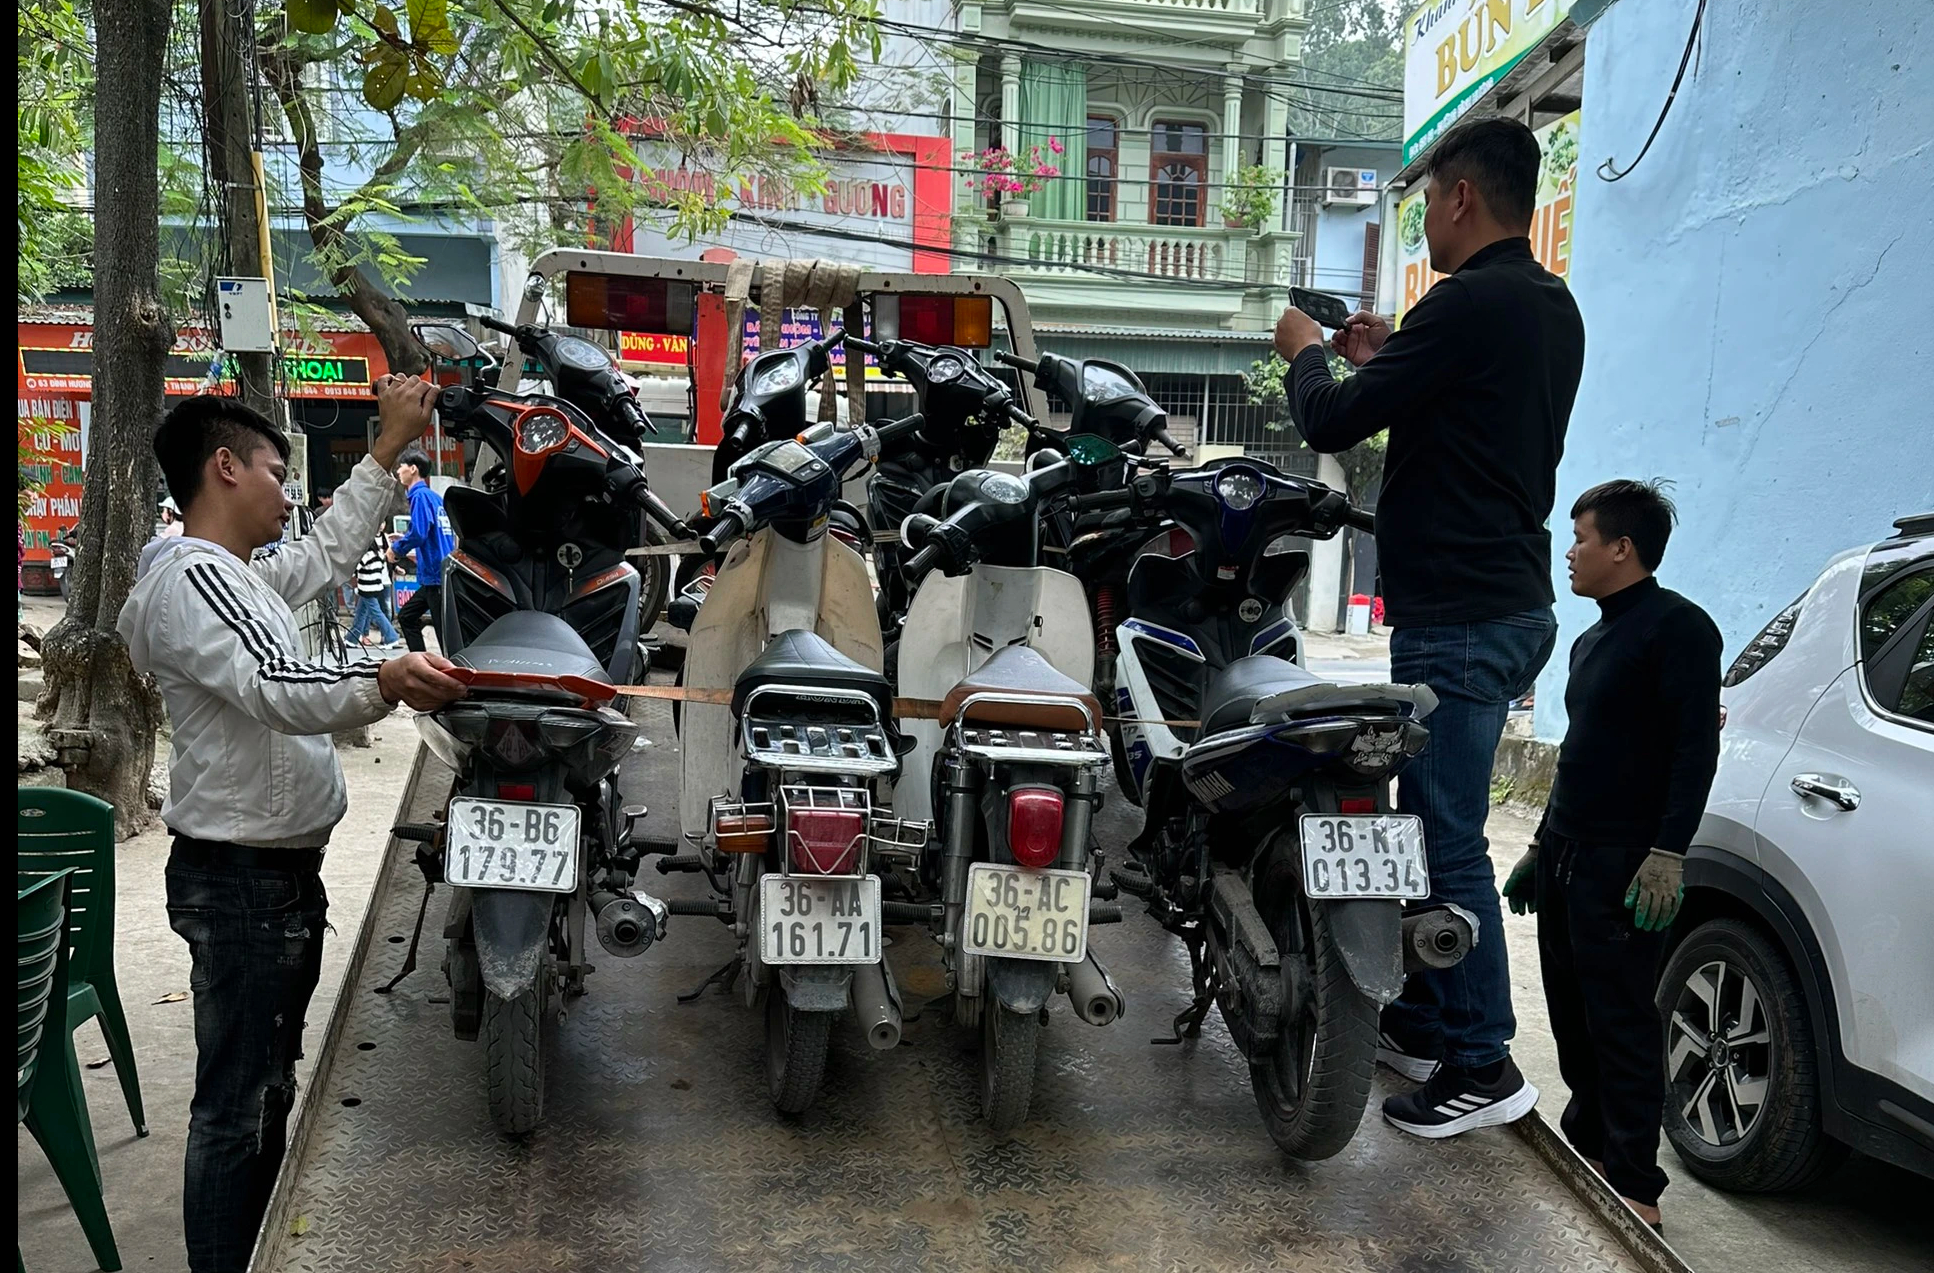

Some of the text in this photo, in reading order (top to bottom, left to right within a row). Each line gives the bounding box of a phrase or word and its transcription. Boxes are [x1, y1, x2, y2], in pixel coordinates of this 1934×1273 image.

[621, 333, 688, 352] DŨNG VÂN
[32, 396, 51, 419] BÁN
[469, 805, 560, 845] 36-B6
[459, 845, 569, 885] 179.77
[1312, 858, 1420, 892] 013.34
[780, 881, 862, 917] 36-AA
[987, 872, 1070, 913] 36-AC
[772, 921, 870, 957] 161.71
[973, 912, 1078, 954] 005.86
